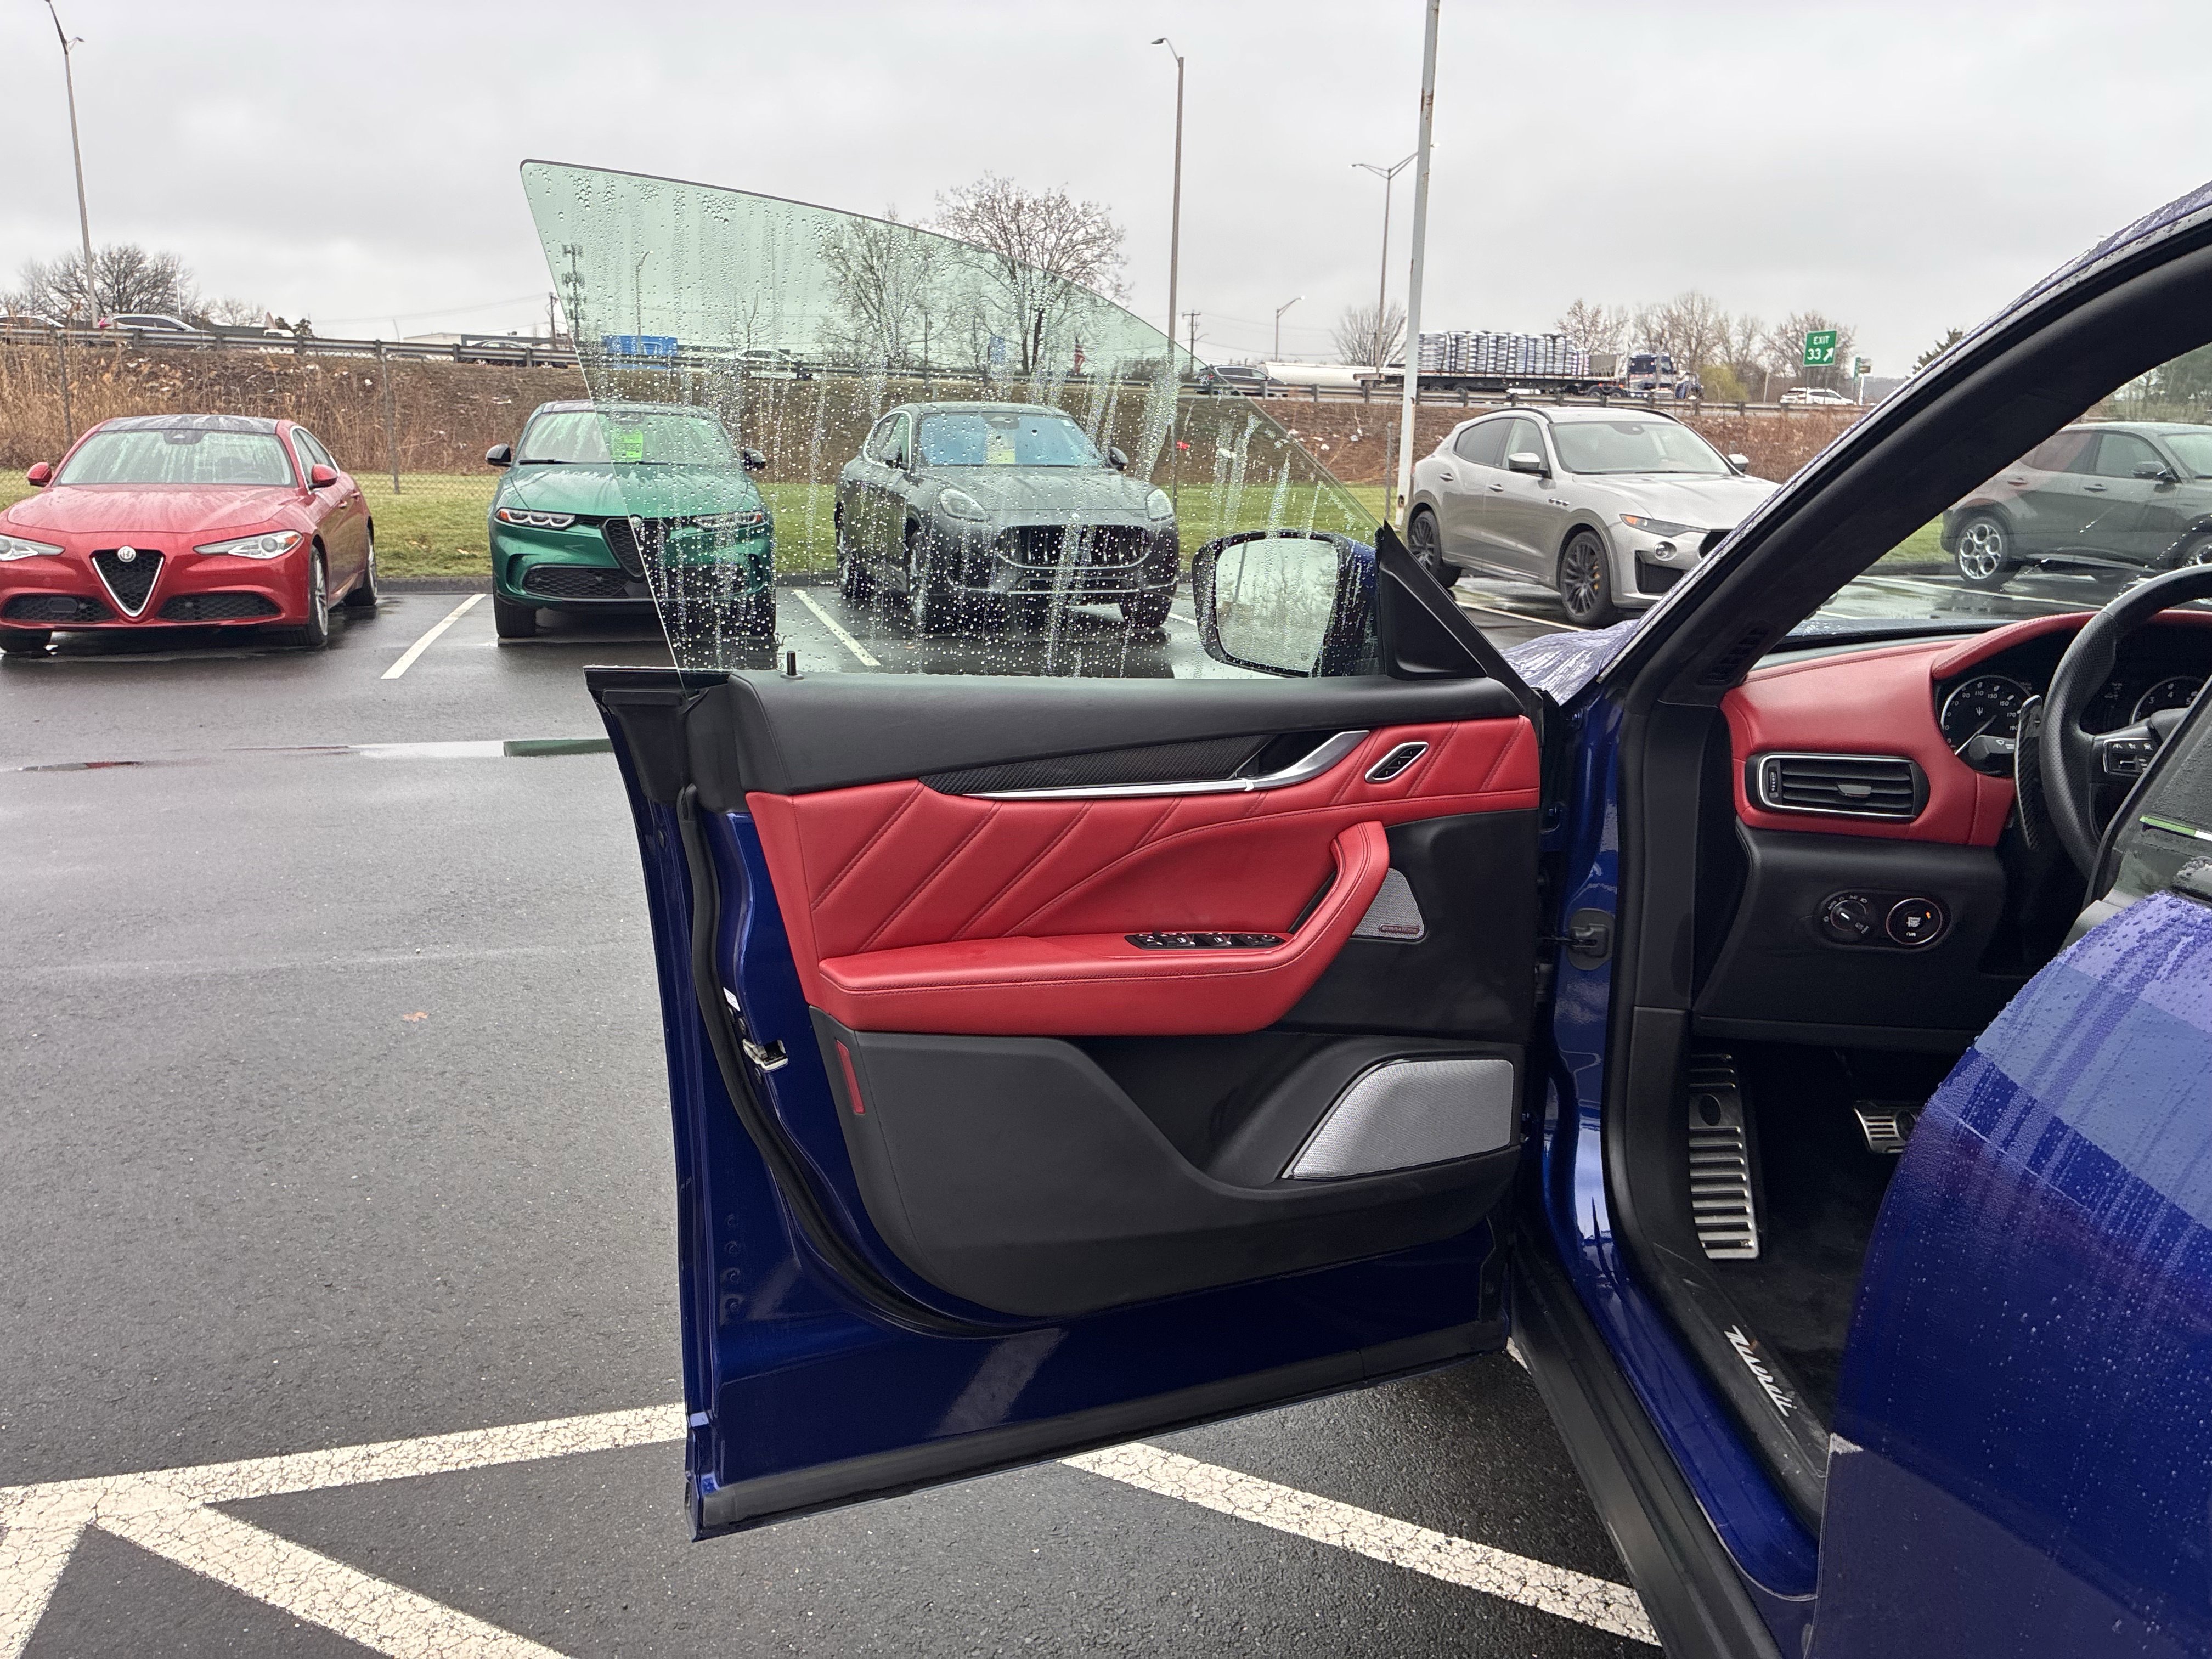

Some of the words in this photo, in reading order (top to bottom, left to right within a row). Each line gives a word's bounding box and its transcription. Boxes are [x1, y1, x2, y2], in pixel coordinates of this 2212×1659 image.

[1813, 335, 1830, 345] EXIT
[1807, 348, 1821, 360] 33
[2148, 696, 2154, 704] 3
[1724, 1324, 1798, 1417] Maserati
